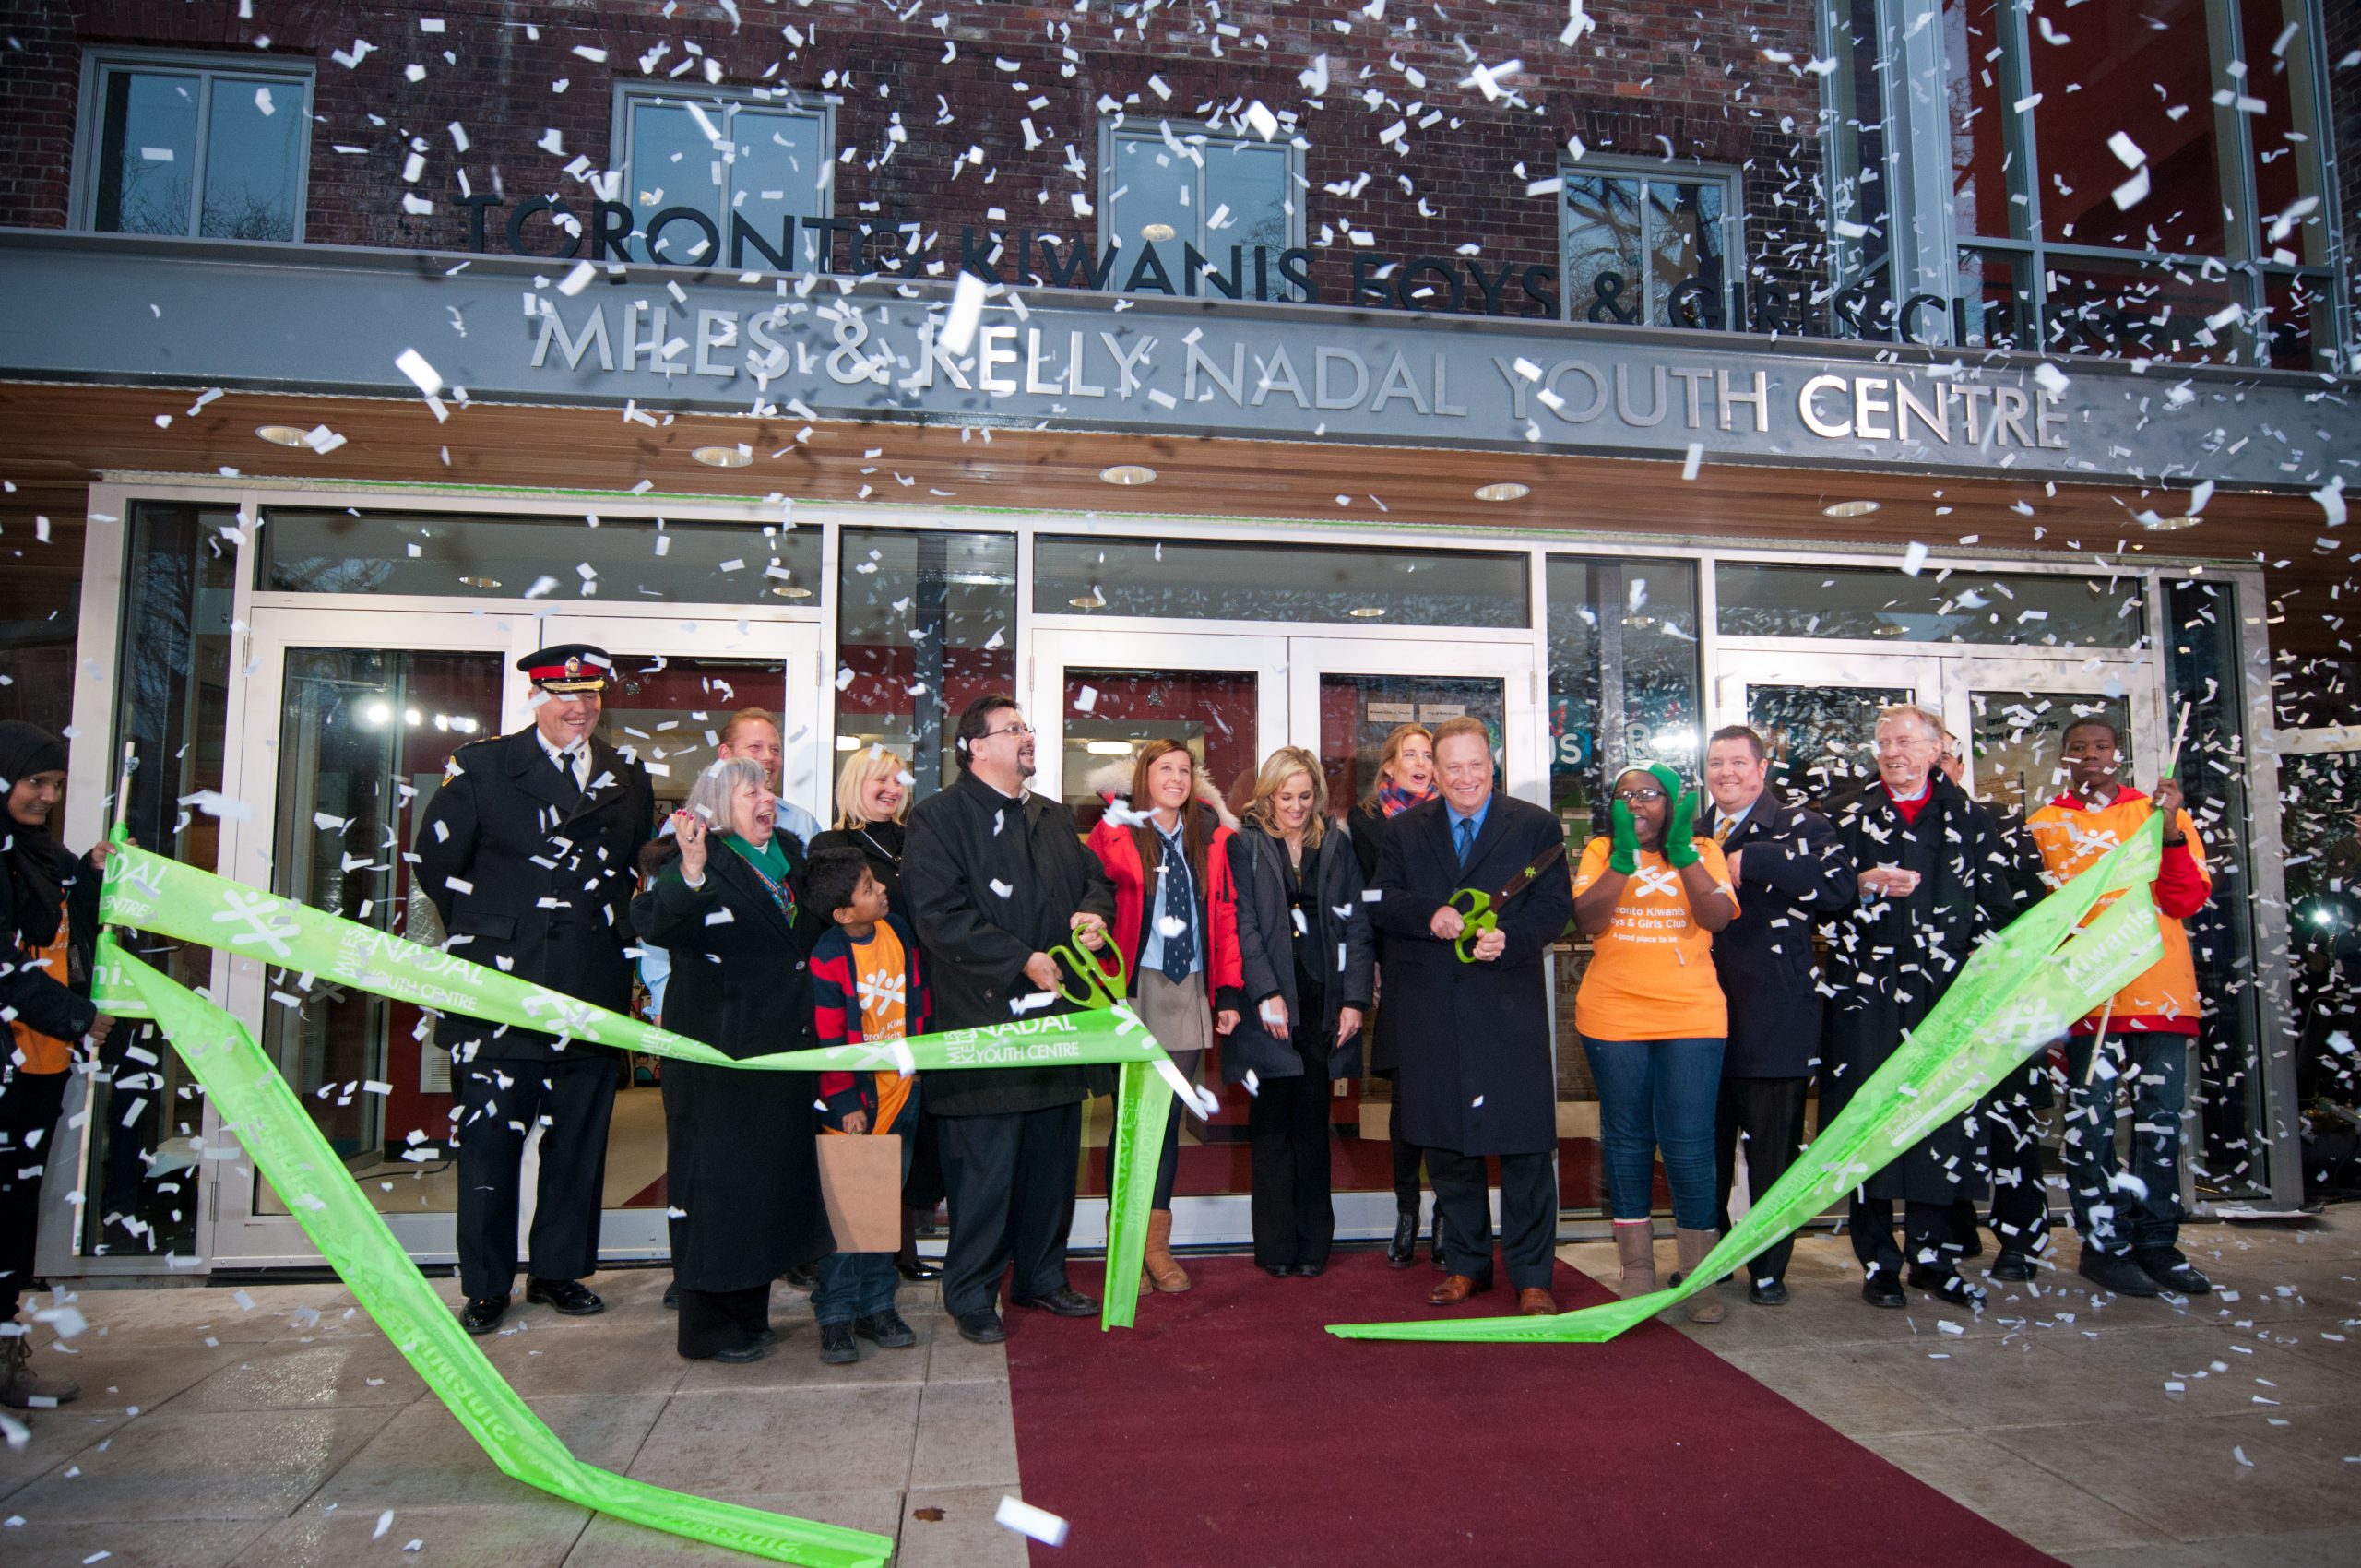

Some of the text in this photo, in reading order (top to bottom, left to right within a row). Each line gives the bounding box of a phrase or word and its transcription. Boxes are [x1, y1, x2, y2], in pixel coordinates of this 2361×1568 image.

[453, 193, 922, 277] TORONTO
[960, 226, 1319, 304] KIWANIS
[1353, 253, 1561, 320] BOYS
[1588, 271, 1637, 325] &
[1669, 277, 1865, 340] GIRLS
[531, 302, 2070, 449] MILES & KELLY NADAL YOUTH CENTRE
[1646, 907, 1686, 917] Kiwanis
[1627, 918, 1635, 927] &
[1637, 919, 1664, 929] Girls
[1636, 935, 1656, 944] place
[1667, 935, 1678, 944] be
[2062, 908, 2154, 984] Kiwanis
[975, 1041, 1080, 1063] YOUTH CENTRE
